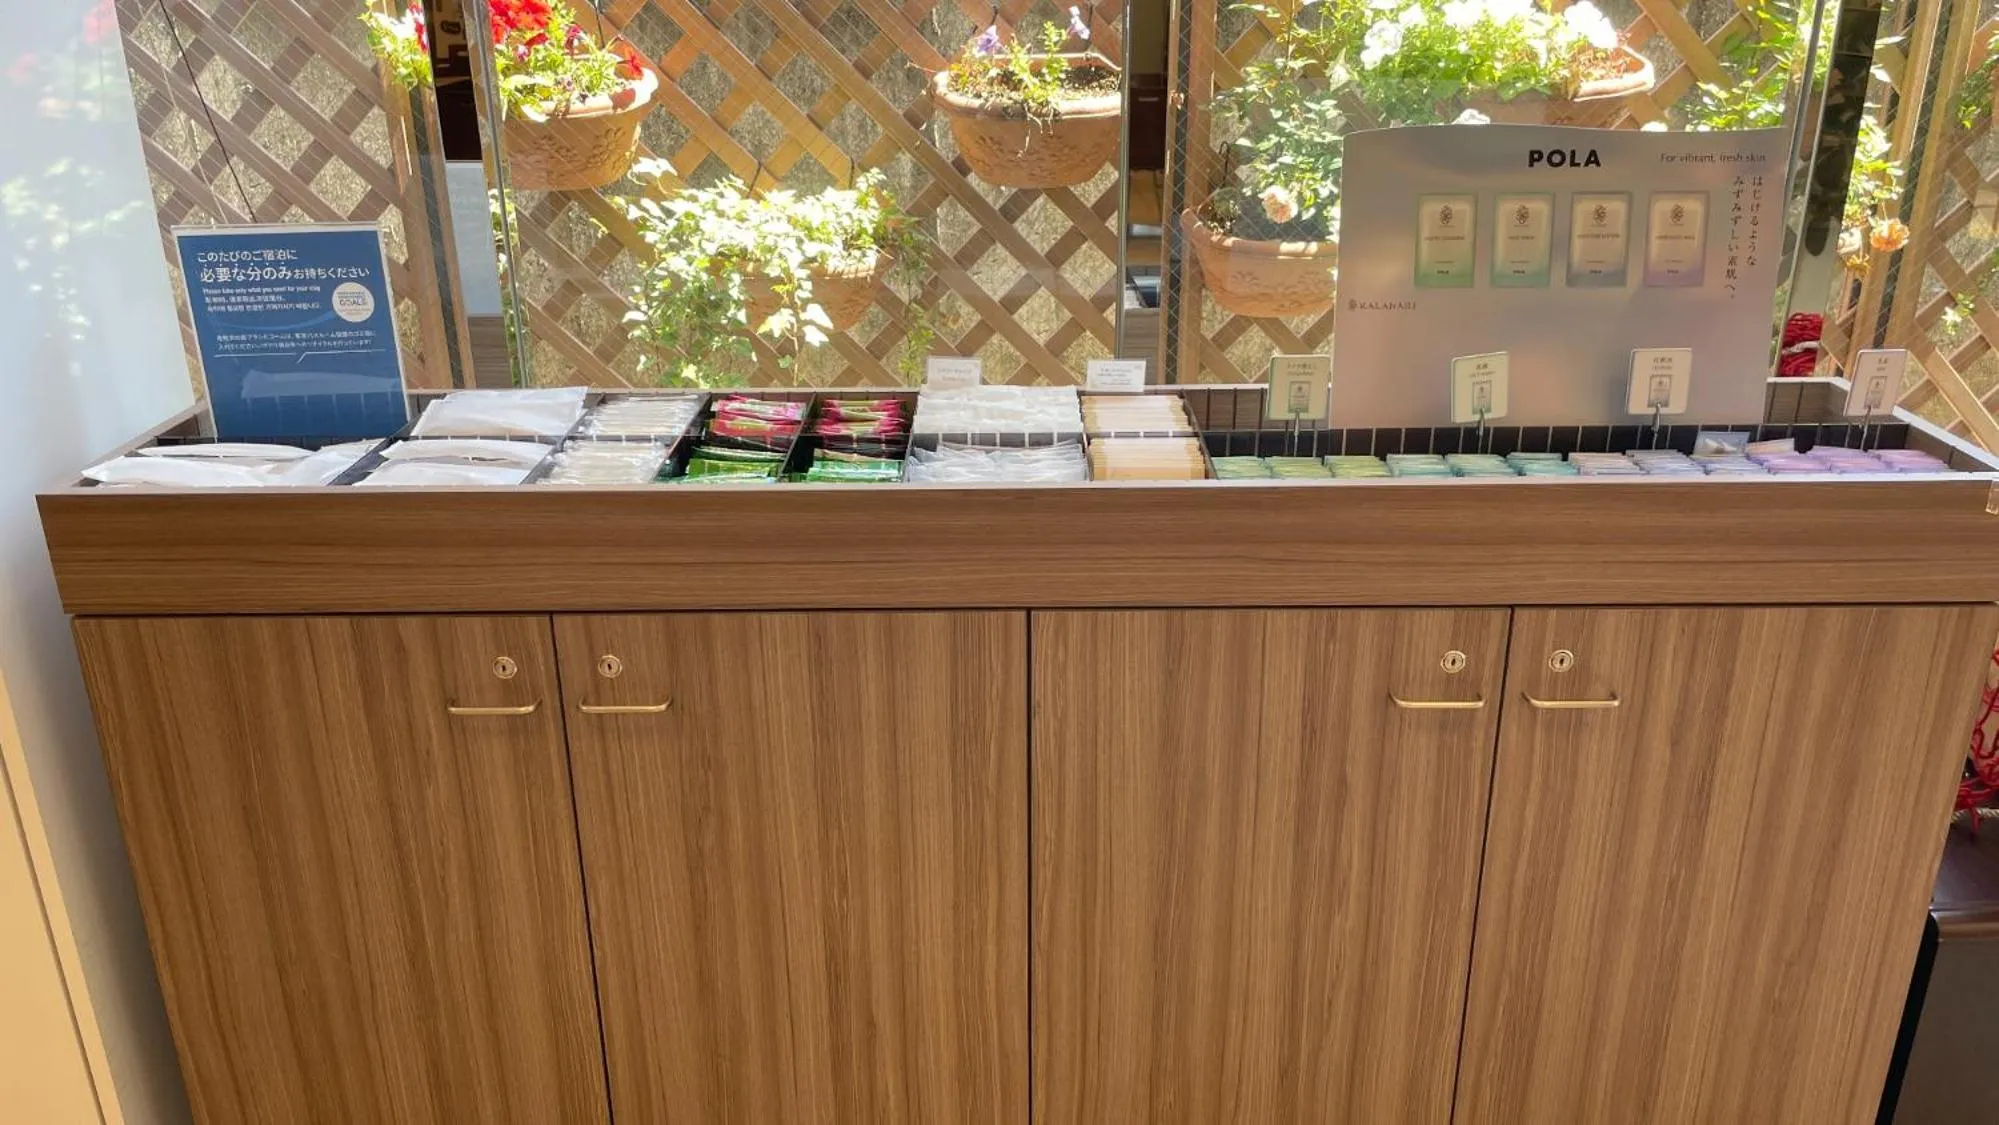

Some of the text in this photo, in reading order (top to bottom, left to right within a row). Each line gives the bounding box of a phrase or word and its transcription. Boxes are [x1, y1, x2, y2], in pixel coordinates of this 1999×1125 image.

[1528, 149, 1601, 168] POLA
[1660, 152, 1676, 163] For
[1720, 151, 1743, 163] fresh
[1745, 150, 1766, 163] skin
[1746, 175, 1763, 266] はじけるような
[197, 249, 298, 263] このたびのご宿泊に
[200, 265, 370, 282] 必要な分のみお持ちください
